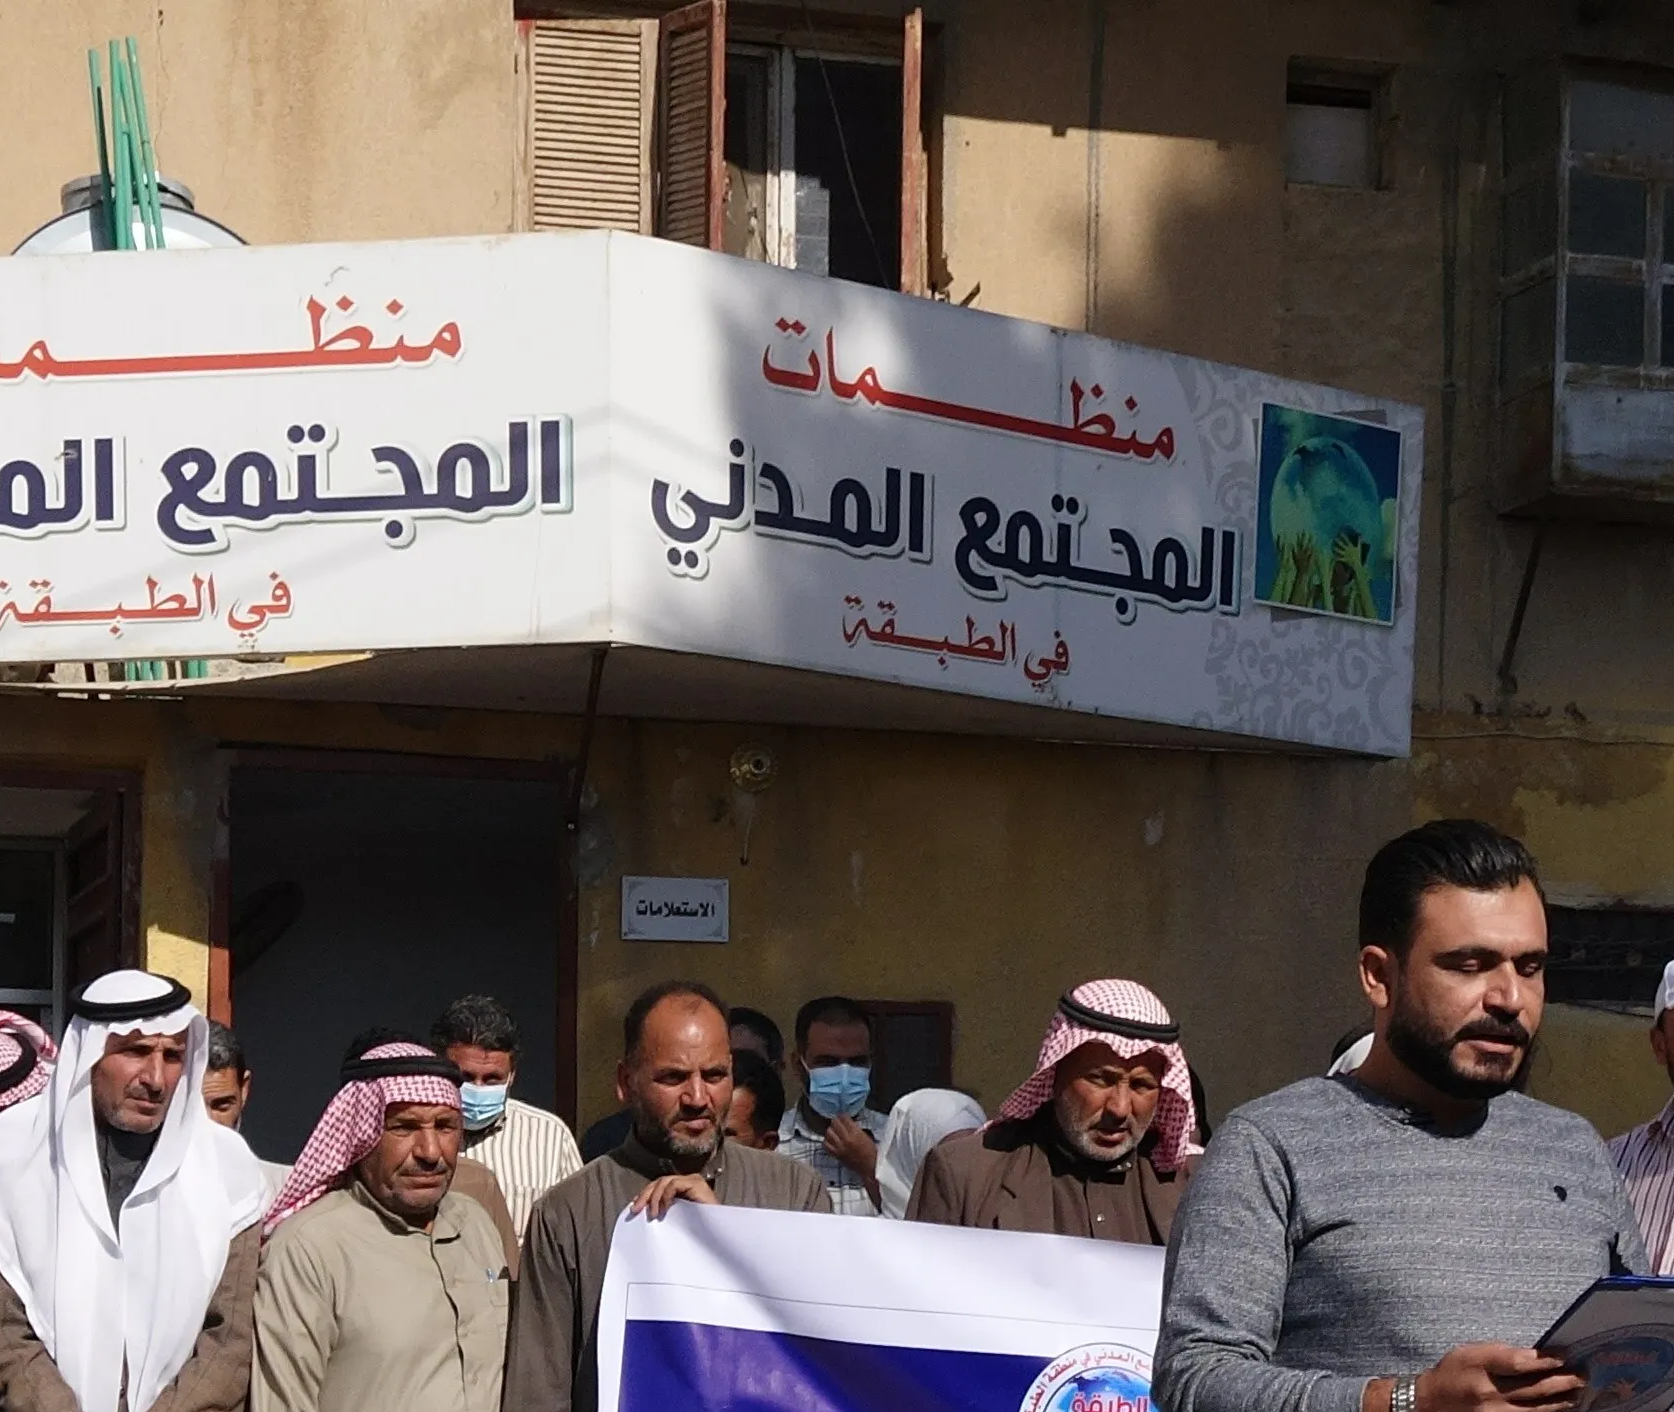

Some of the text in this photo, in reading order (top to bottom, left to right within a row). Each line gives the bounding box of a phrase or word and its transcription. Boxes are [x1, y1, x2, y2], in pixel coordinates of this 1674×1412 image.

[762, 319, 1176, 461] منظمات
[157, 420, 565, 546] المجتمع
[651, 438, 1236, 615] المجتمع المدني
[227, 572, 292, 641] في
[843, 596, 1071, 688] في الطبقة
[635, 899, 716, 918] الاستعلامات
